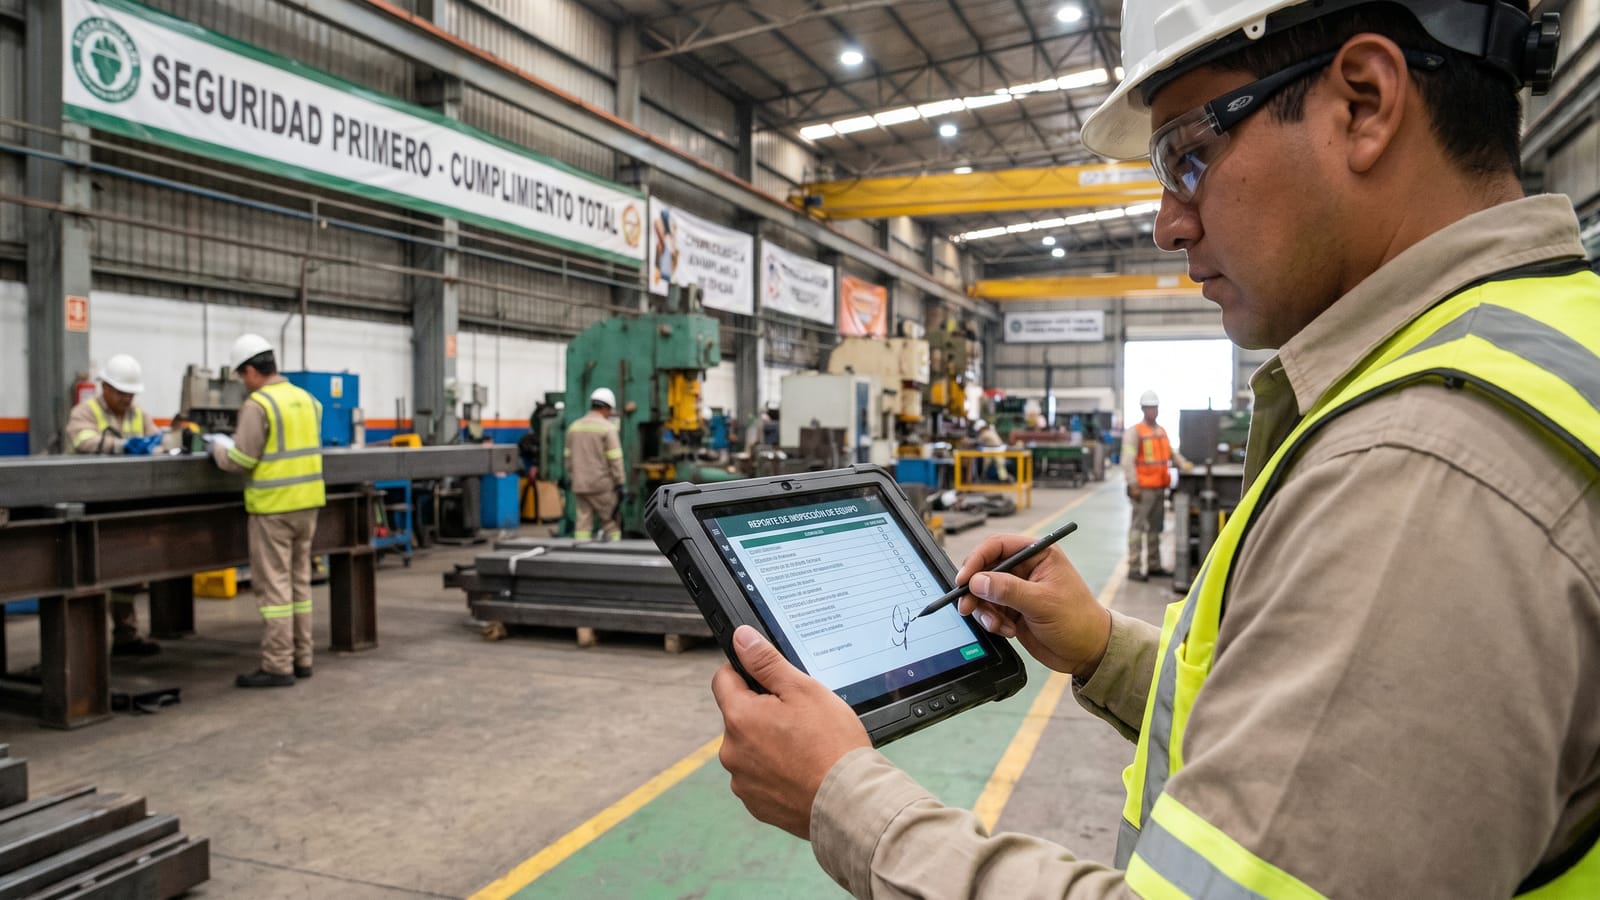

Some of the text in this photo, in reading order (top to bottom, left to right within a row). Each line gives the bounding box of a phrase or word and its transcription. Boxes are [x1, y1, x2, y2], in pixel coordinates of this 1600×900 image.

[152, 54, 322, 145] SEGURIDAD
[333, 114, 432, 177] PRIMERO
[451, 153, 574, 211] CUMPLIMIENTO
[578, 195, 618, 235] TOTAL
[748, 505, 858, 528] REPORTE DE INSPECCIÓN DE EQUIPO
